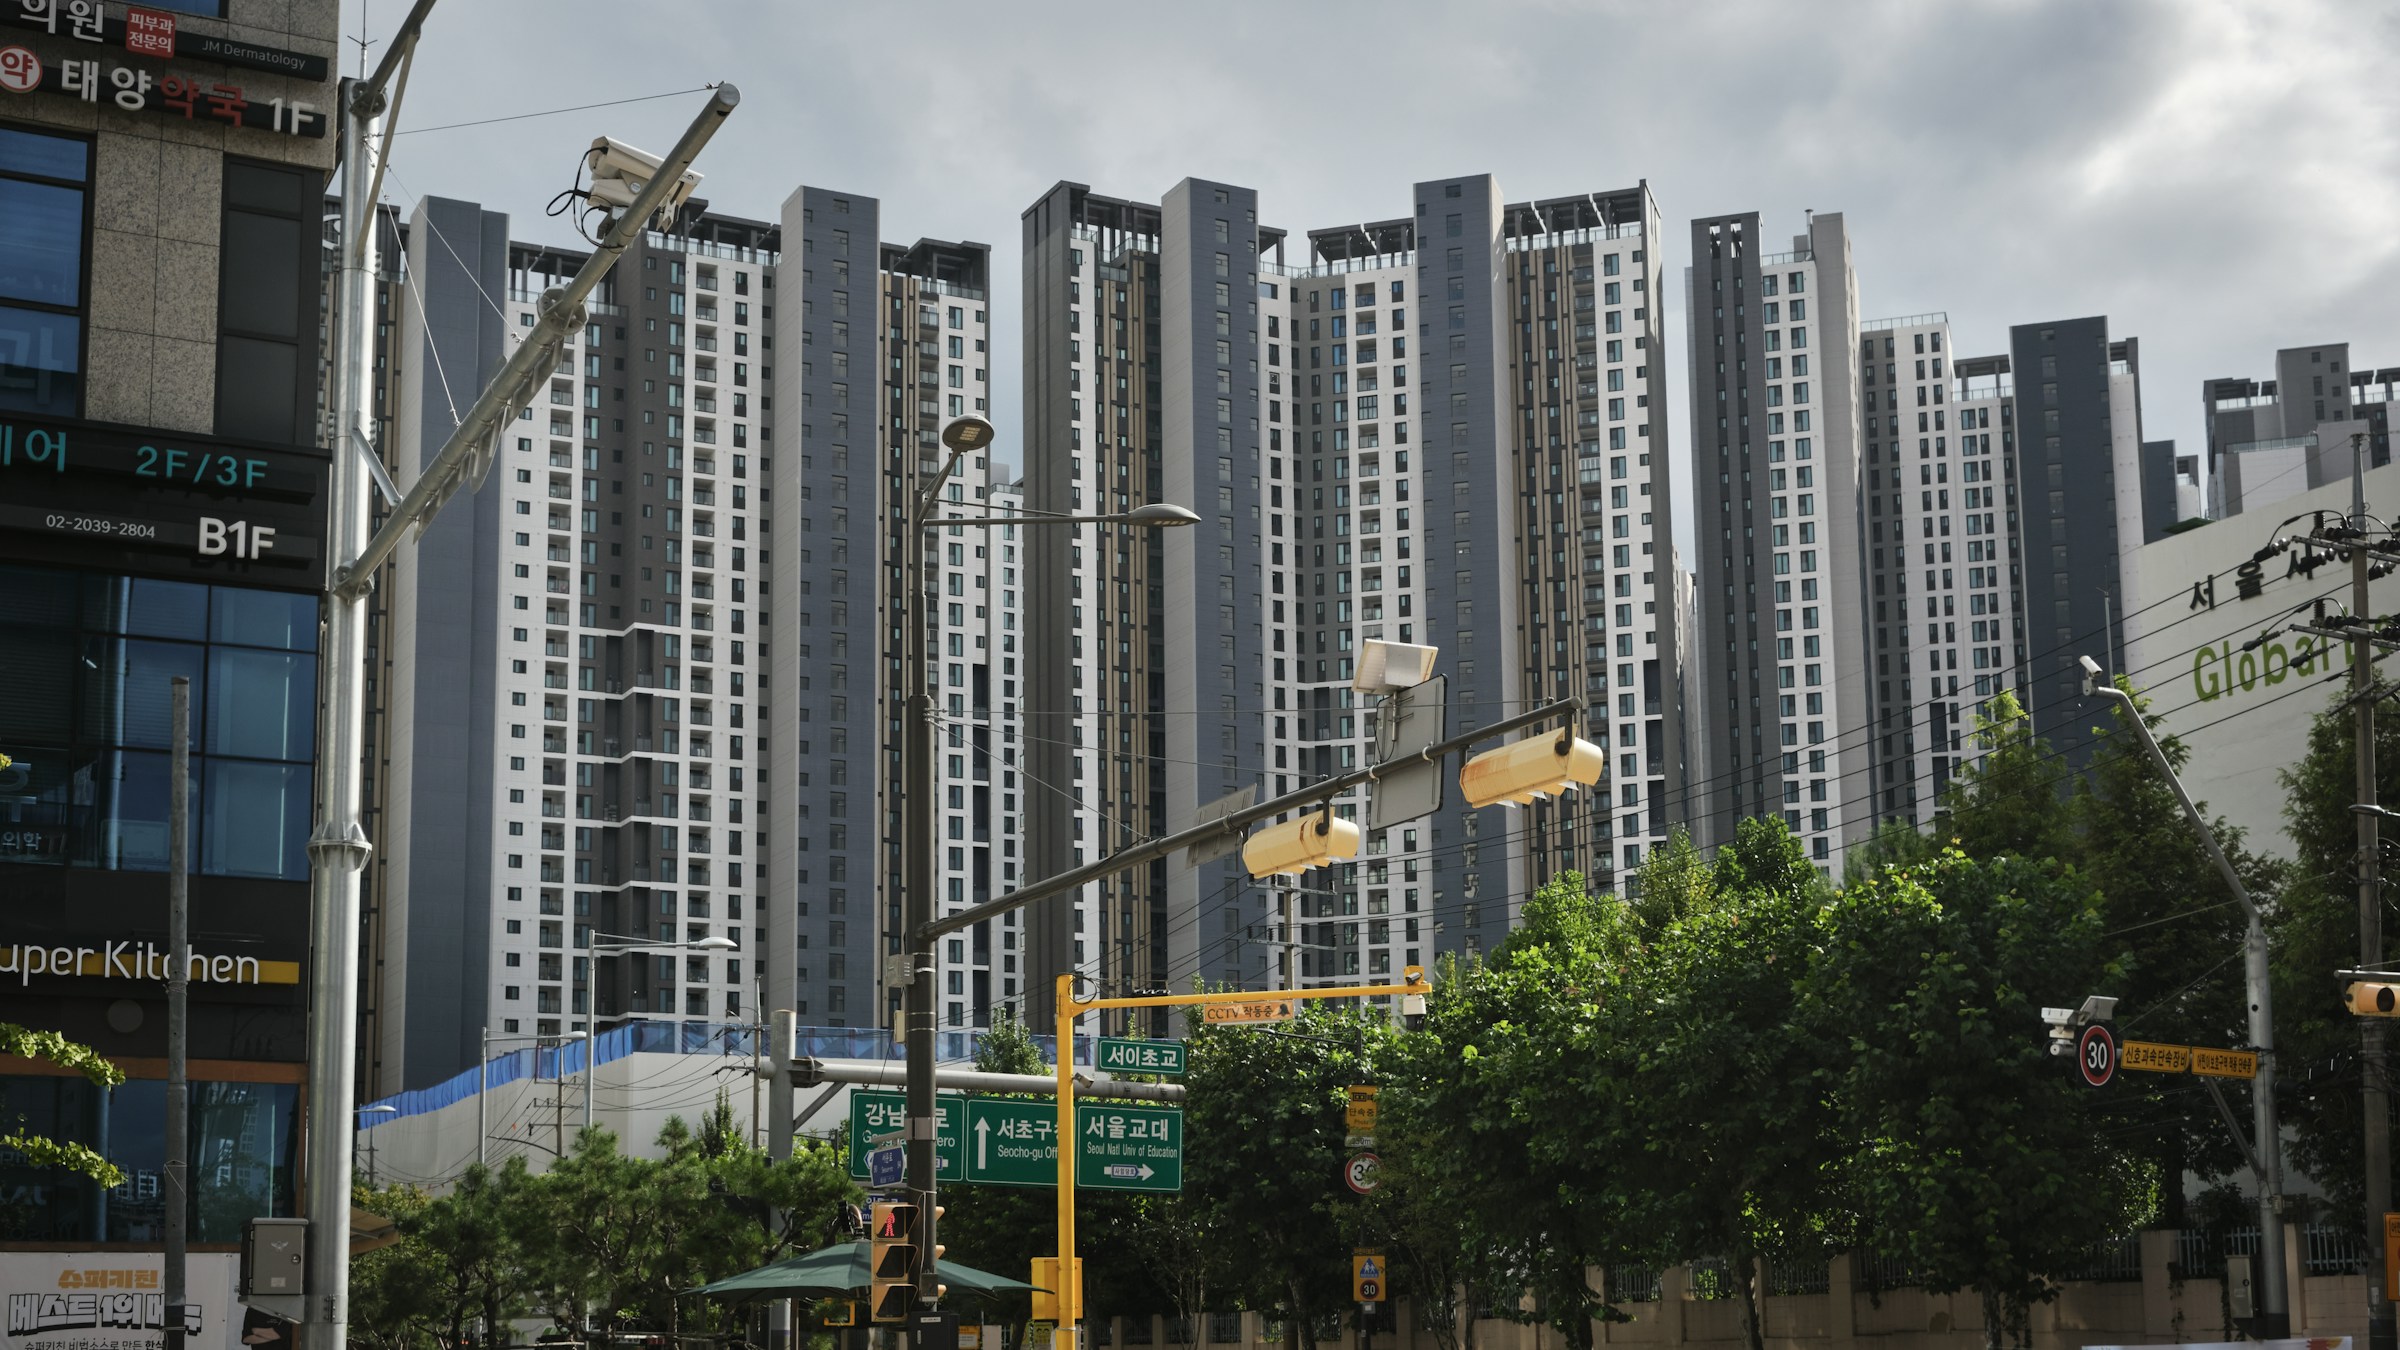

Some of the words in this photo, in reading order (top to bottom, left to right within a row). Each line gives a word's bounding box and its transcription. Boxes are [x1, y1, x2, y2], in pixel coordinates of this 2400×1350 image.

[20, 0, 104, 43] 의원
[130, 13, 174, 34] 피부과
[129, 31, 172, 53] 전문의
[202, 39, 220, 53] JM
[224, 43, 306, 70] Dermatology
[1, 52, 33, 86] 약
[61, 59, 248, 129] 태양약국
[269, 97, 316, 136] 1F
[136, 446, 269, 489] 2F/3F
[46, 514, 156, 539] 02-2039-2804
[199, 517, 276, 560] B1F
[1207, 1004, 1241, 1021] CCTV
[1243, 1004, 1273, 1019] 작동중
[1107, 1046, 1179, 1068] 서이초교
[2087, 1040, 2108, 1070] 30
[865, 1102, 950, 1128] 강남로
[997, 1117, 1058, 1141] 서초구
[1086, 1115, 1169, 1141] 서울교대
[997, 1145, 1044, 1162] Seocho-gu
[1087, 1141, 1105, 1155] Seoul
[1122, 1143, 1137, 1156] Univ
[1138, 1144, 1146, 1157] of
[1147, 1145, 1178, 1159] Education
[58, 1270, 159, 1289] 슈퍼키친
[1363, 1284, 1376, 1295] 30
[8, 1293, 97, 1338] 베스트
[100, 1293, 143, 1331] 1위
